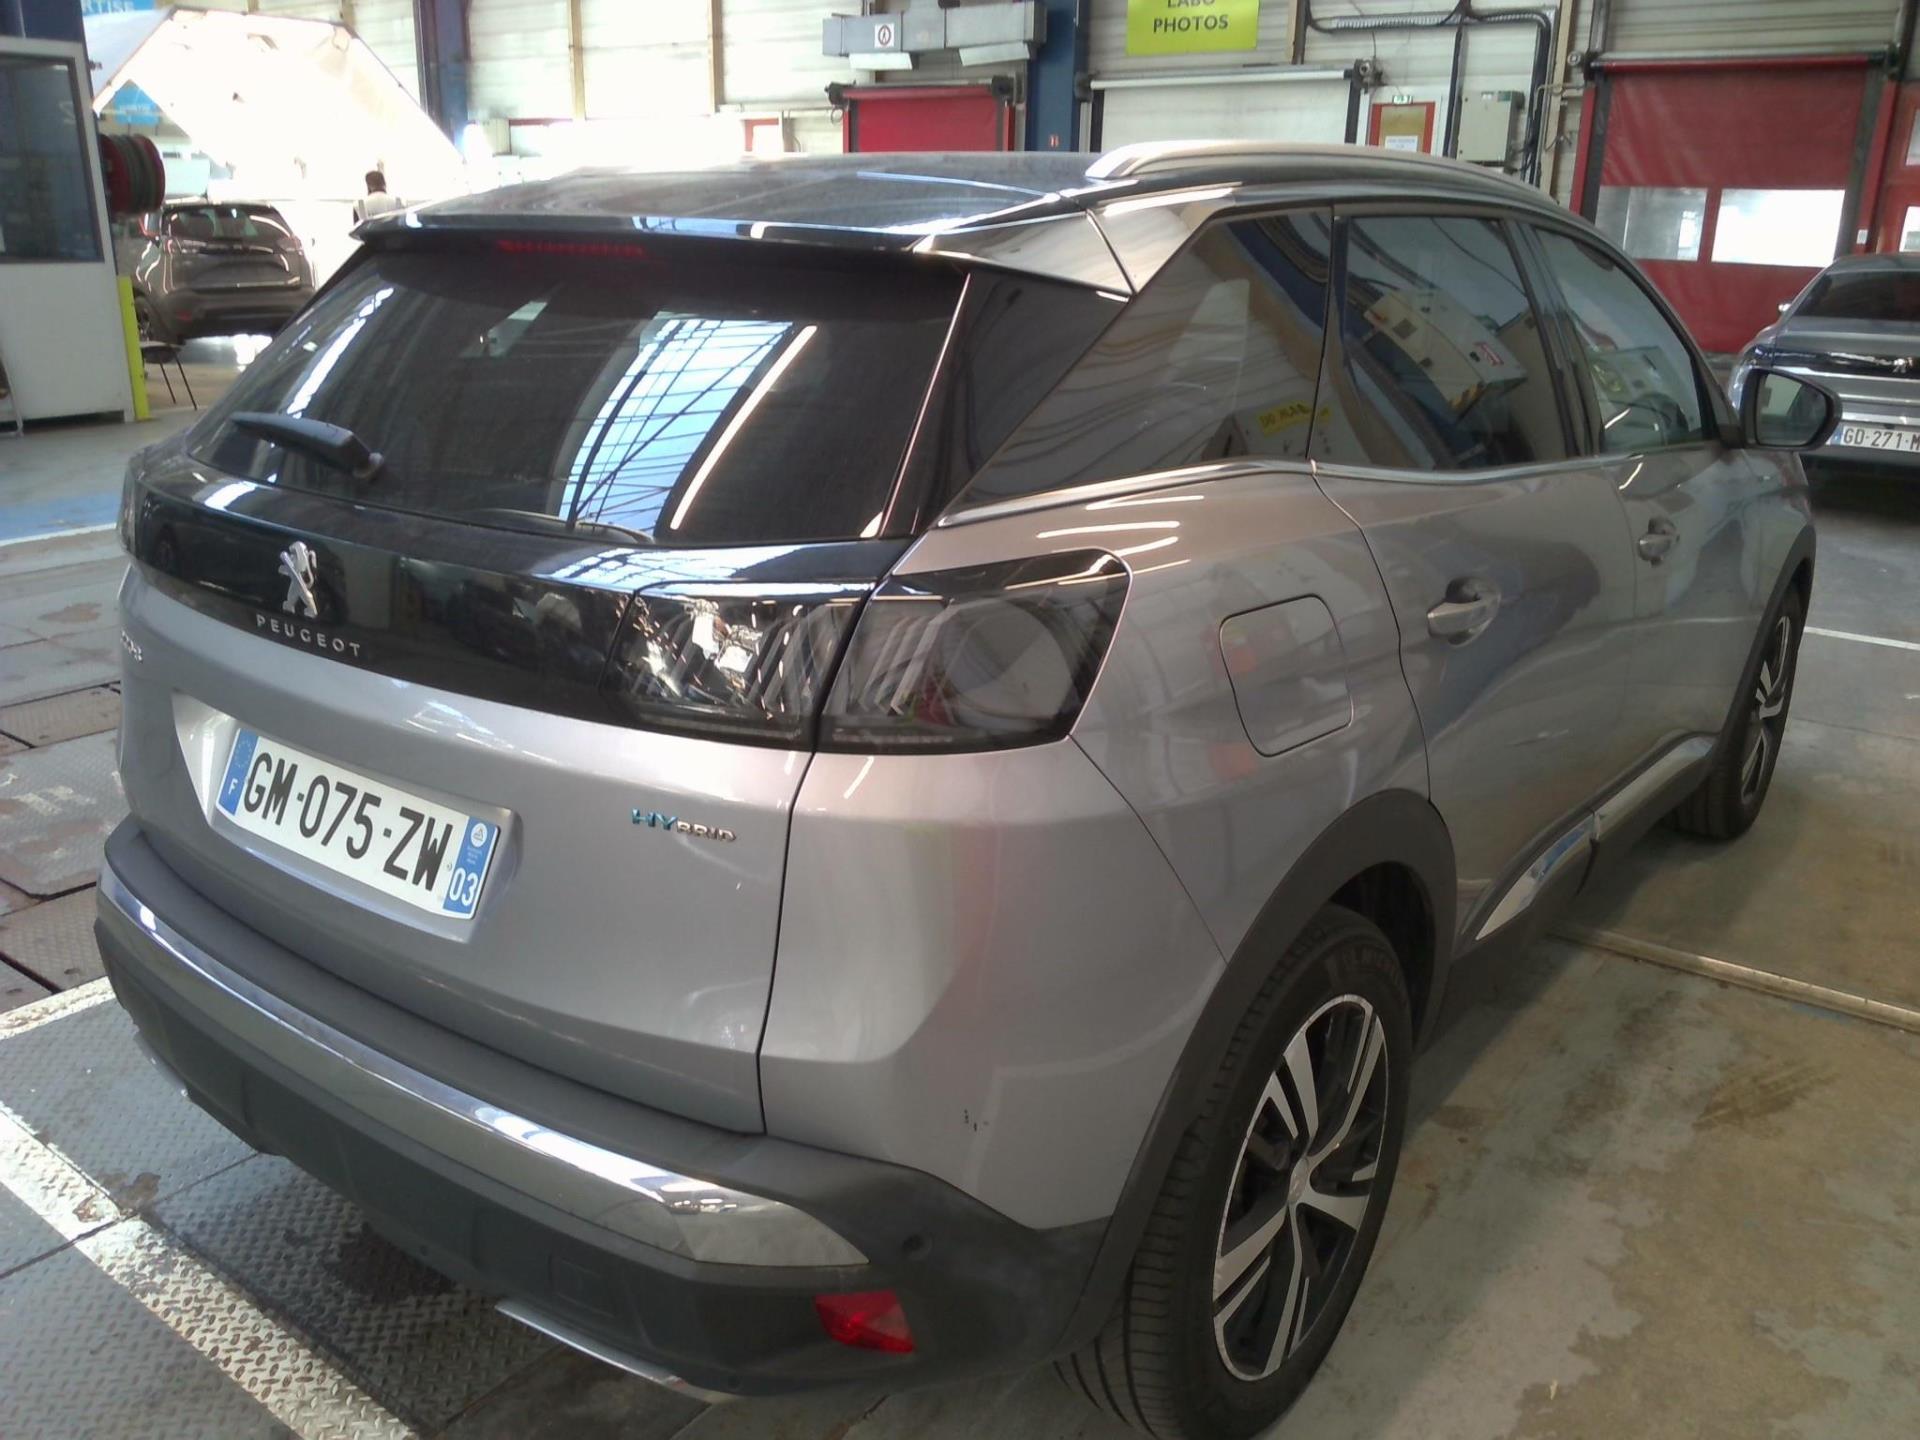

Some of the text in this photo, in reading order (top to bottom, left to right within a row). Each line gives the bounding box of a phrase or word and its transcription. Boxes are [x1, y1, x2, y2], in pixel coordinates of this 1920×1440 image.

[1153, 14, 1229, 33] PHOTOS
[256, 613, 360, 657] PEUGEOT
[227, 777, 239, 795] F
[243, 752, 453, 892] GM-075-ZW
[631, 808, 737, 842] HYBRID
[449, 867, 479, 906] 03
